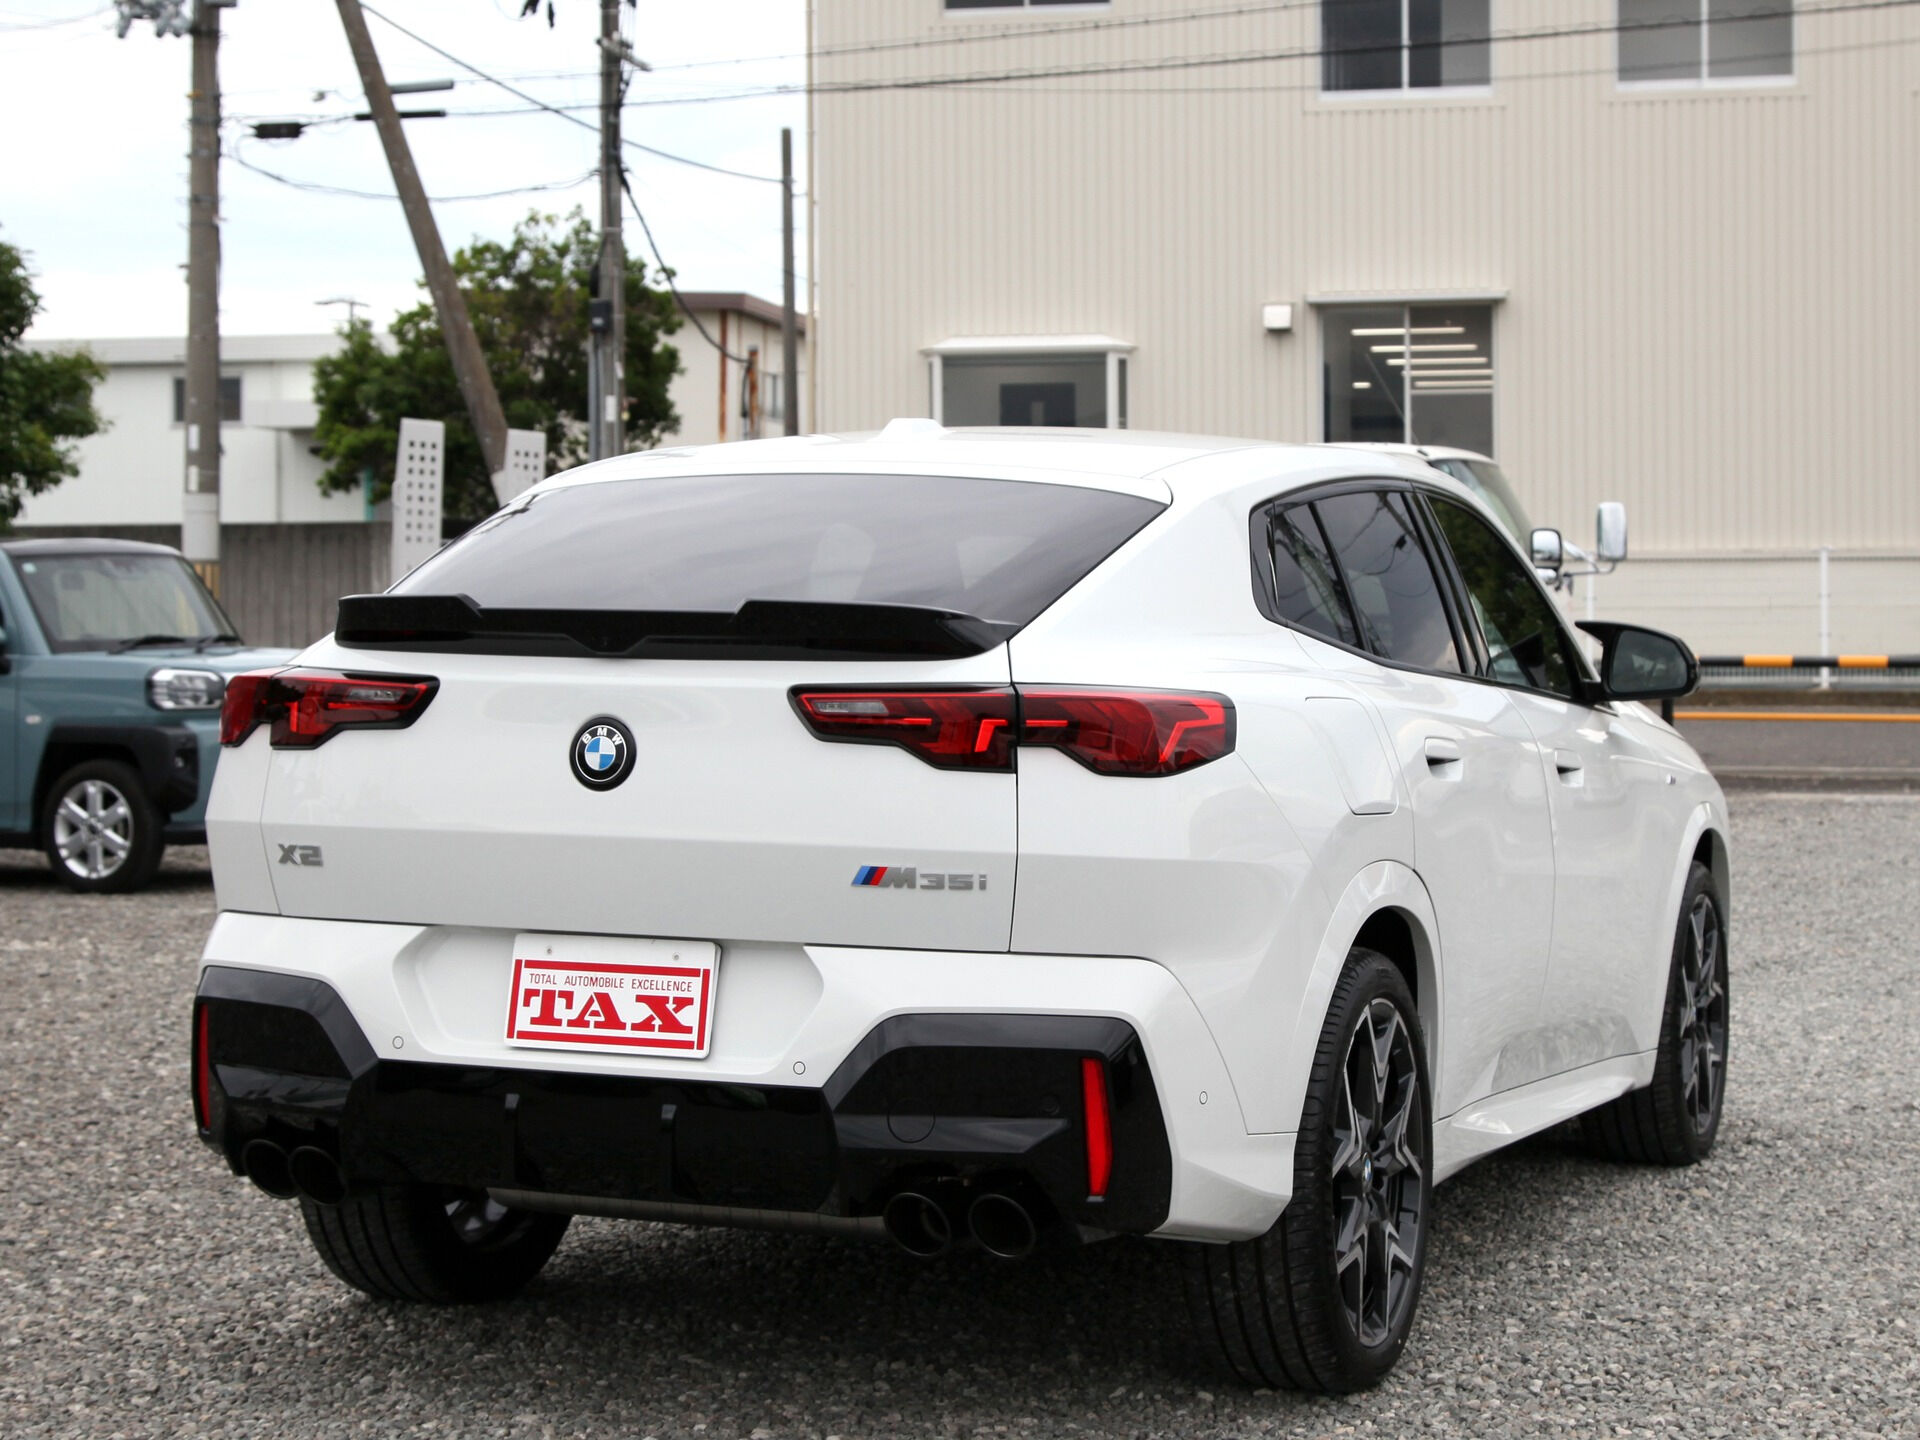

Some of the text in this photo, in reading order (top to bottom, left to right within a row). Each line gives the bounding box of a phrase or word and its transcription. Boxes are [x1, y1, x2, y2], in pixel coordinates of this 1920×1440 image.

[582, 727, 623, 746] BMW
[278, 843, 323, 867] X2
[529, 973, 692, 992] TOTAL AUTOMOBILE EXCELLENCE
[522, 988, 694, 1034] TAX
